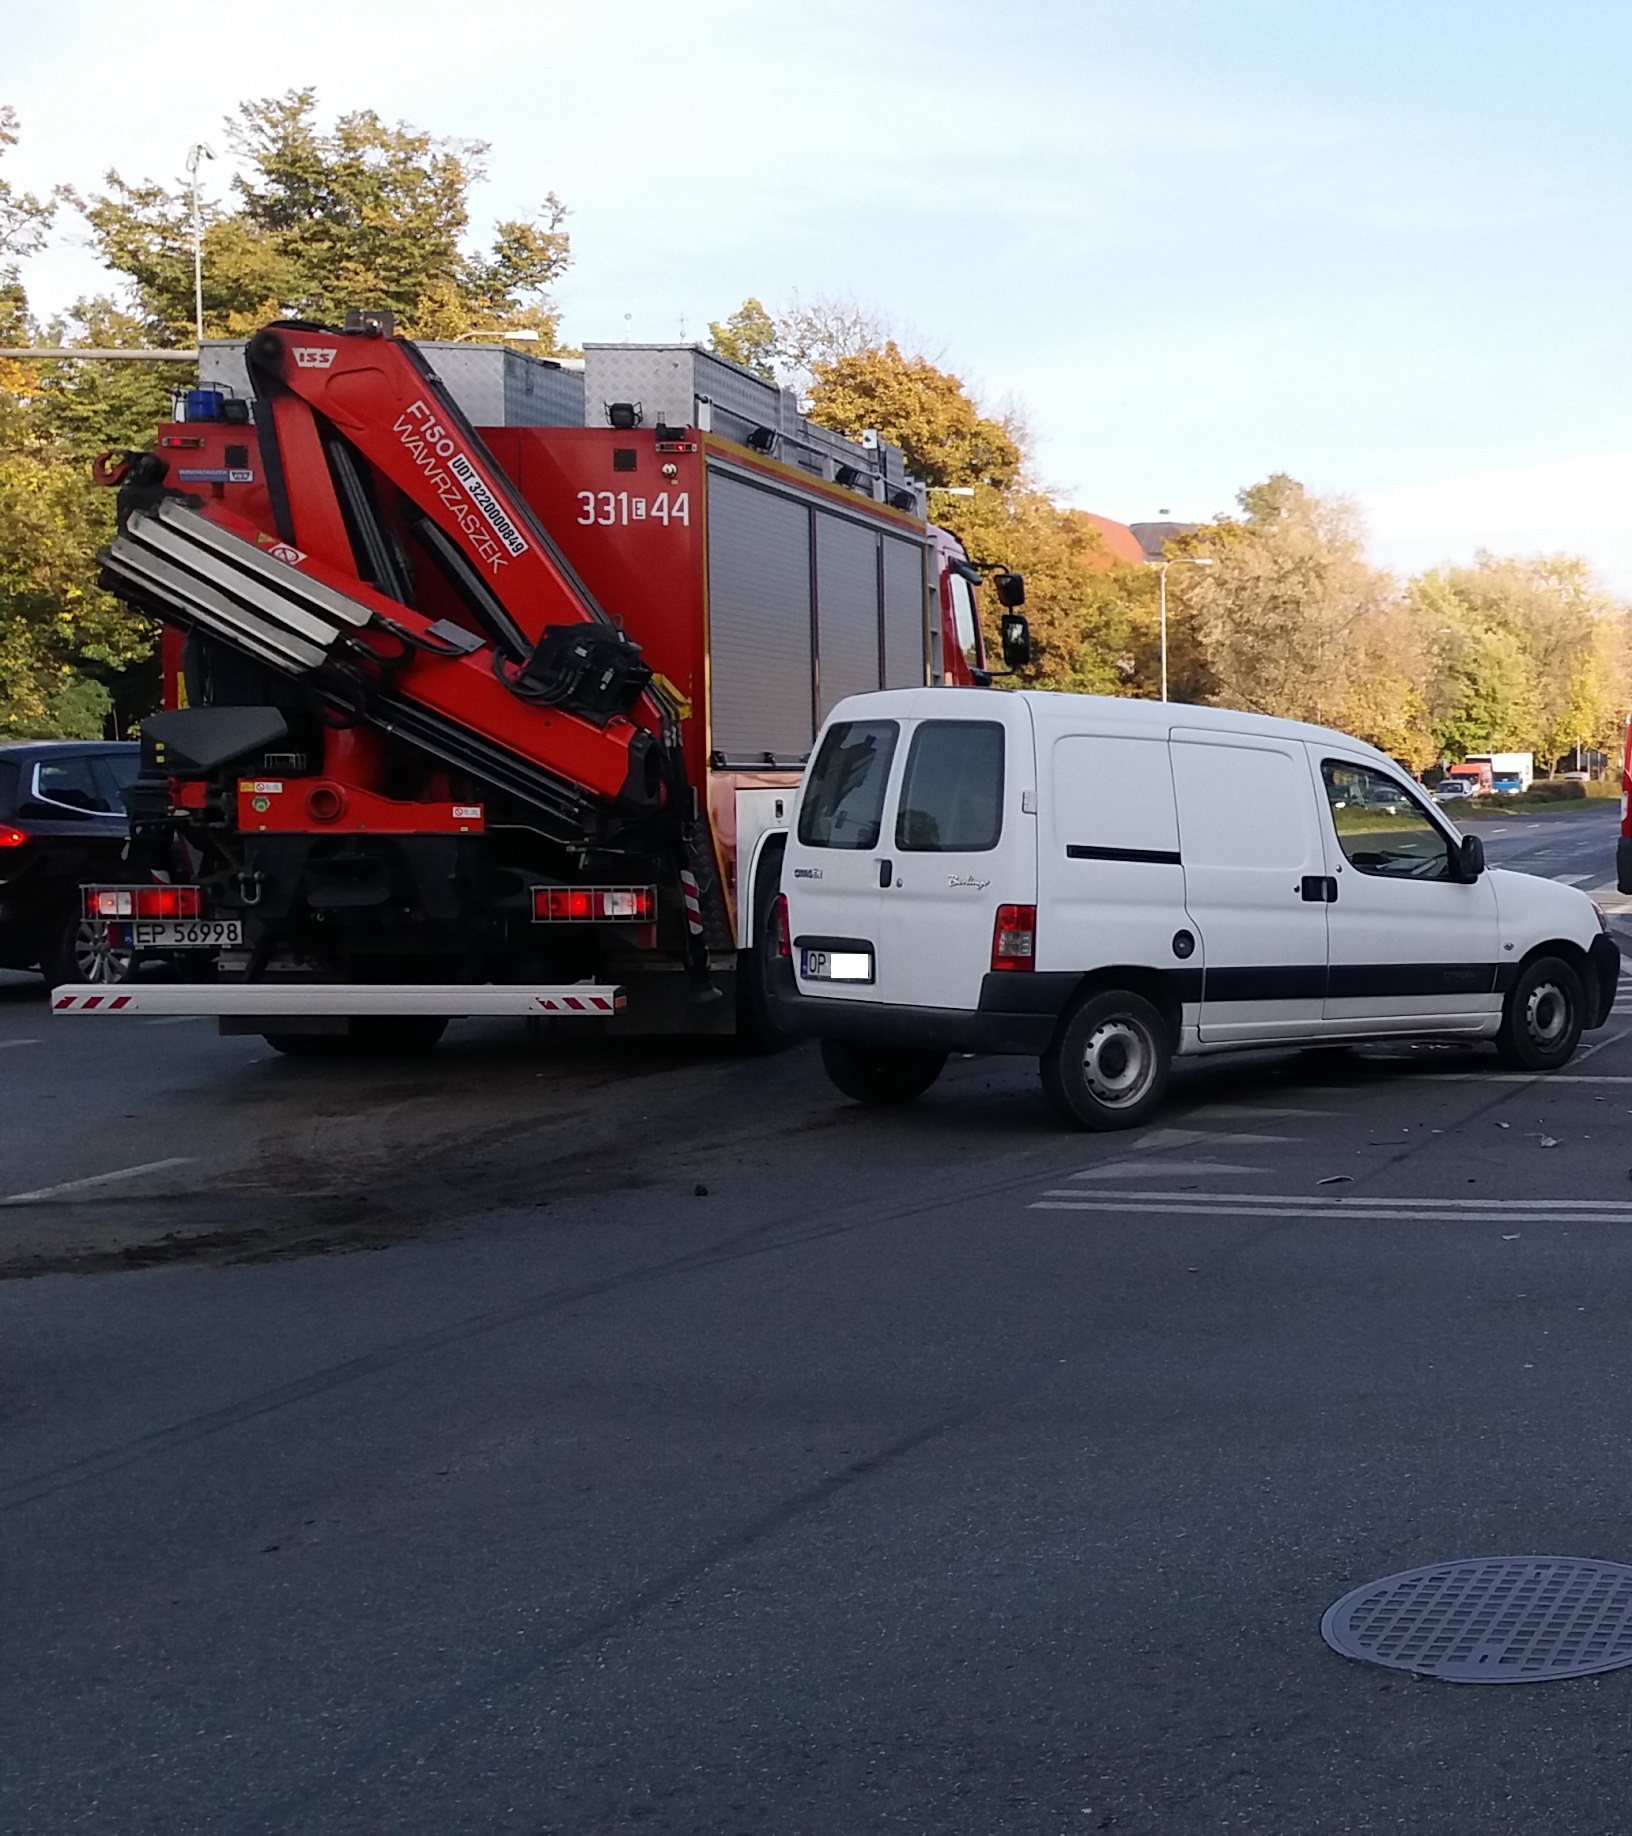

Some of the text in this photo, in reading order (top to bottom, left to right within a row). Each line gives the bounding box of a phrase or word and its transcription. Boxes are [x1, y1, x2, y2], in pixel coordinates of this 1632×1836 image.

[299, 352, 330, 363] ISS
[406, 400, 525, 554] F150 UDT 3220000849
[392, 414, 508, 575] WAWRZASZEK
[948, 874, 991, 890] Berlingo
[136, 922, 239, 944] EP 56998
[809, 952, 827, 974] OP
